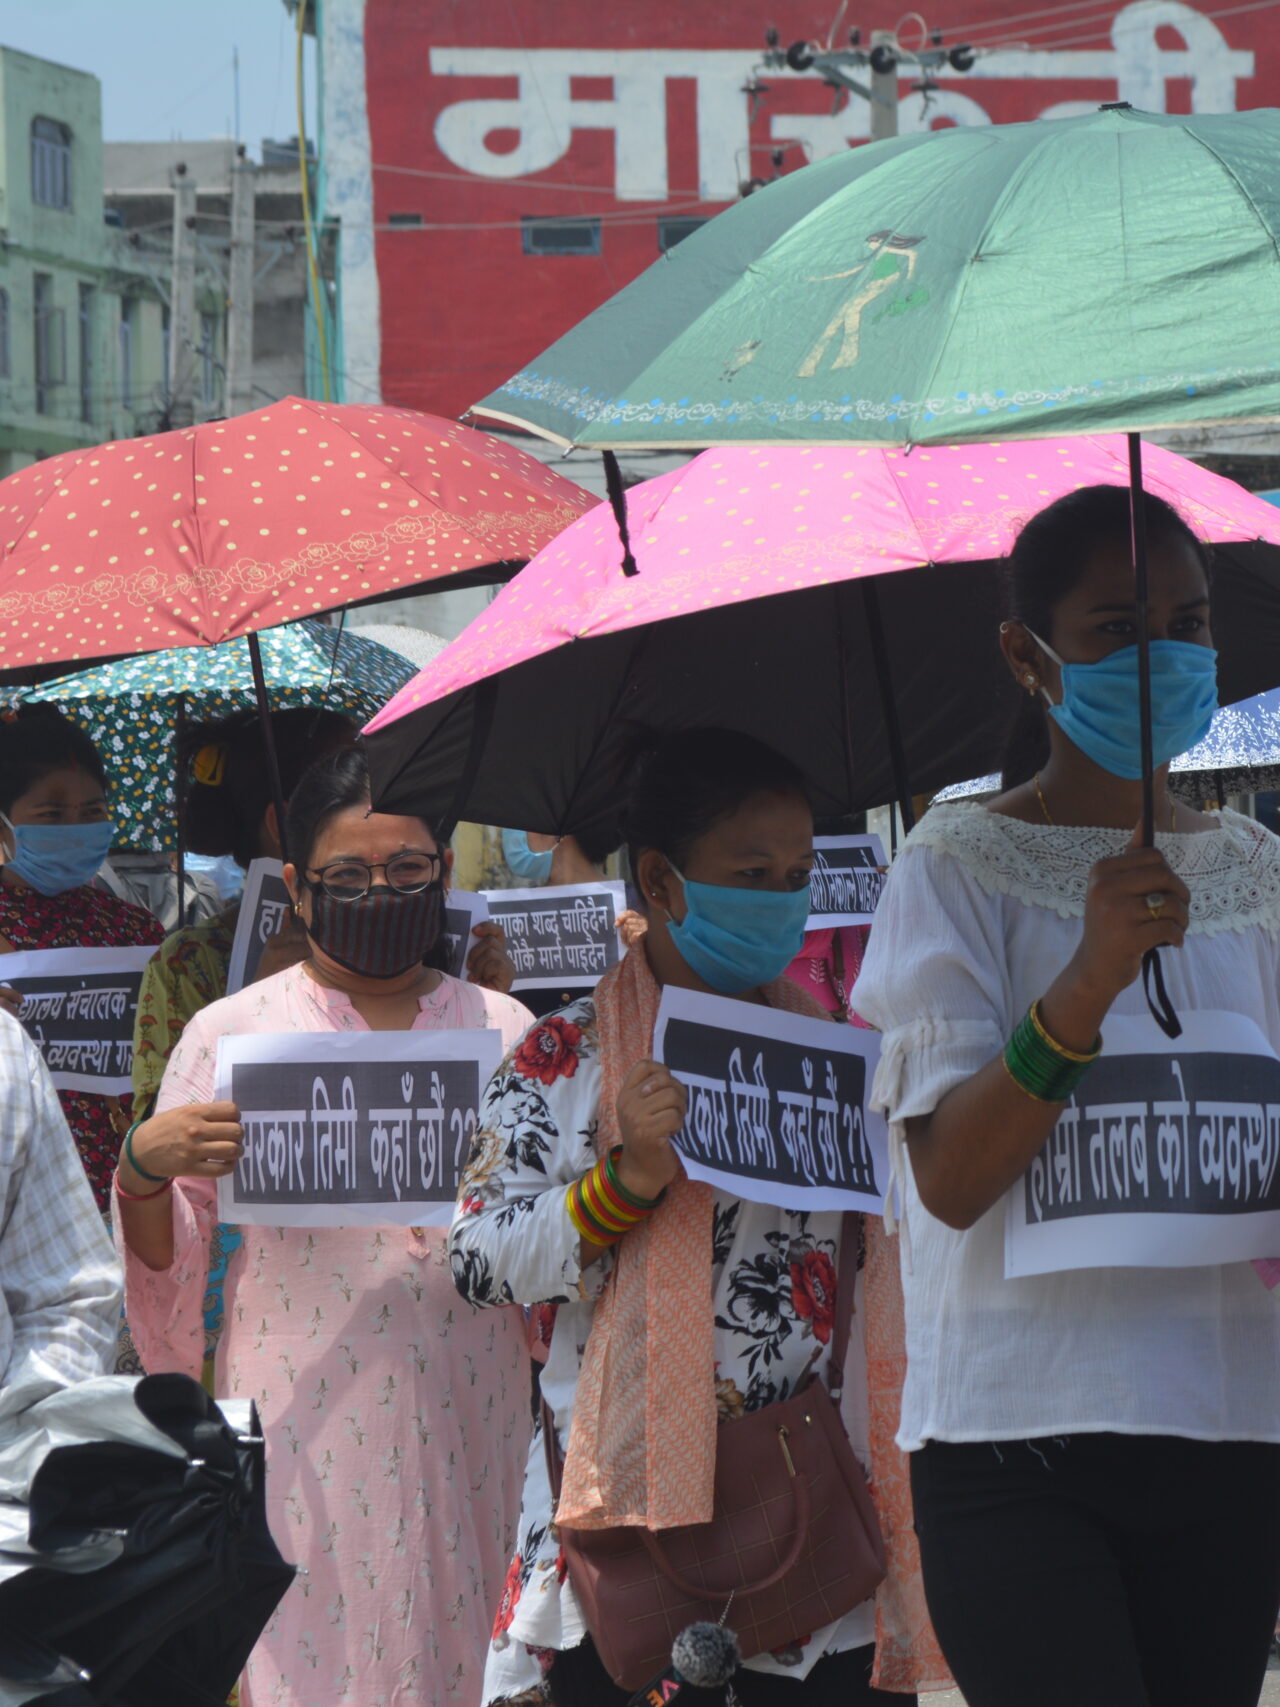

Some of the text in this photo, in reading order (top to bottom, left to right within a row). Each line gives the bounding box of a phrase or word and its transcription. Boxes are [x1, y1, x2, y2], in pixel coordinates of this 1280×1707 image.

[47, 1039, 113, 1074] व्यवस्था
[310, 1075, 358, 1191] तिमी
[368, 1071, 413, 1201] कहाँ
[1085, 1102, 1149, 1201] तलब
